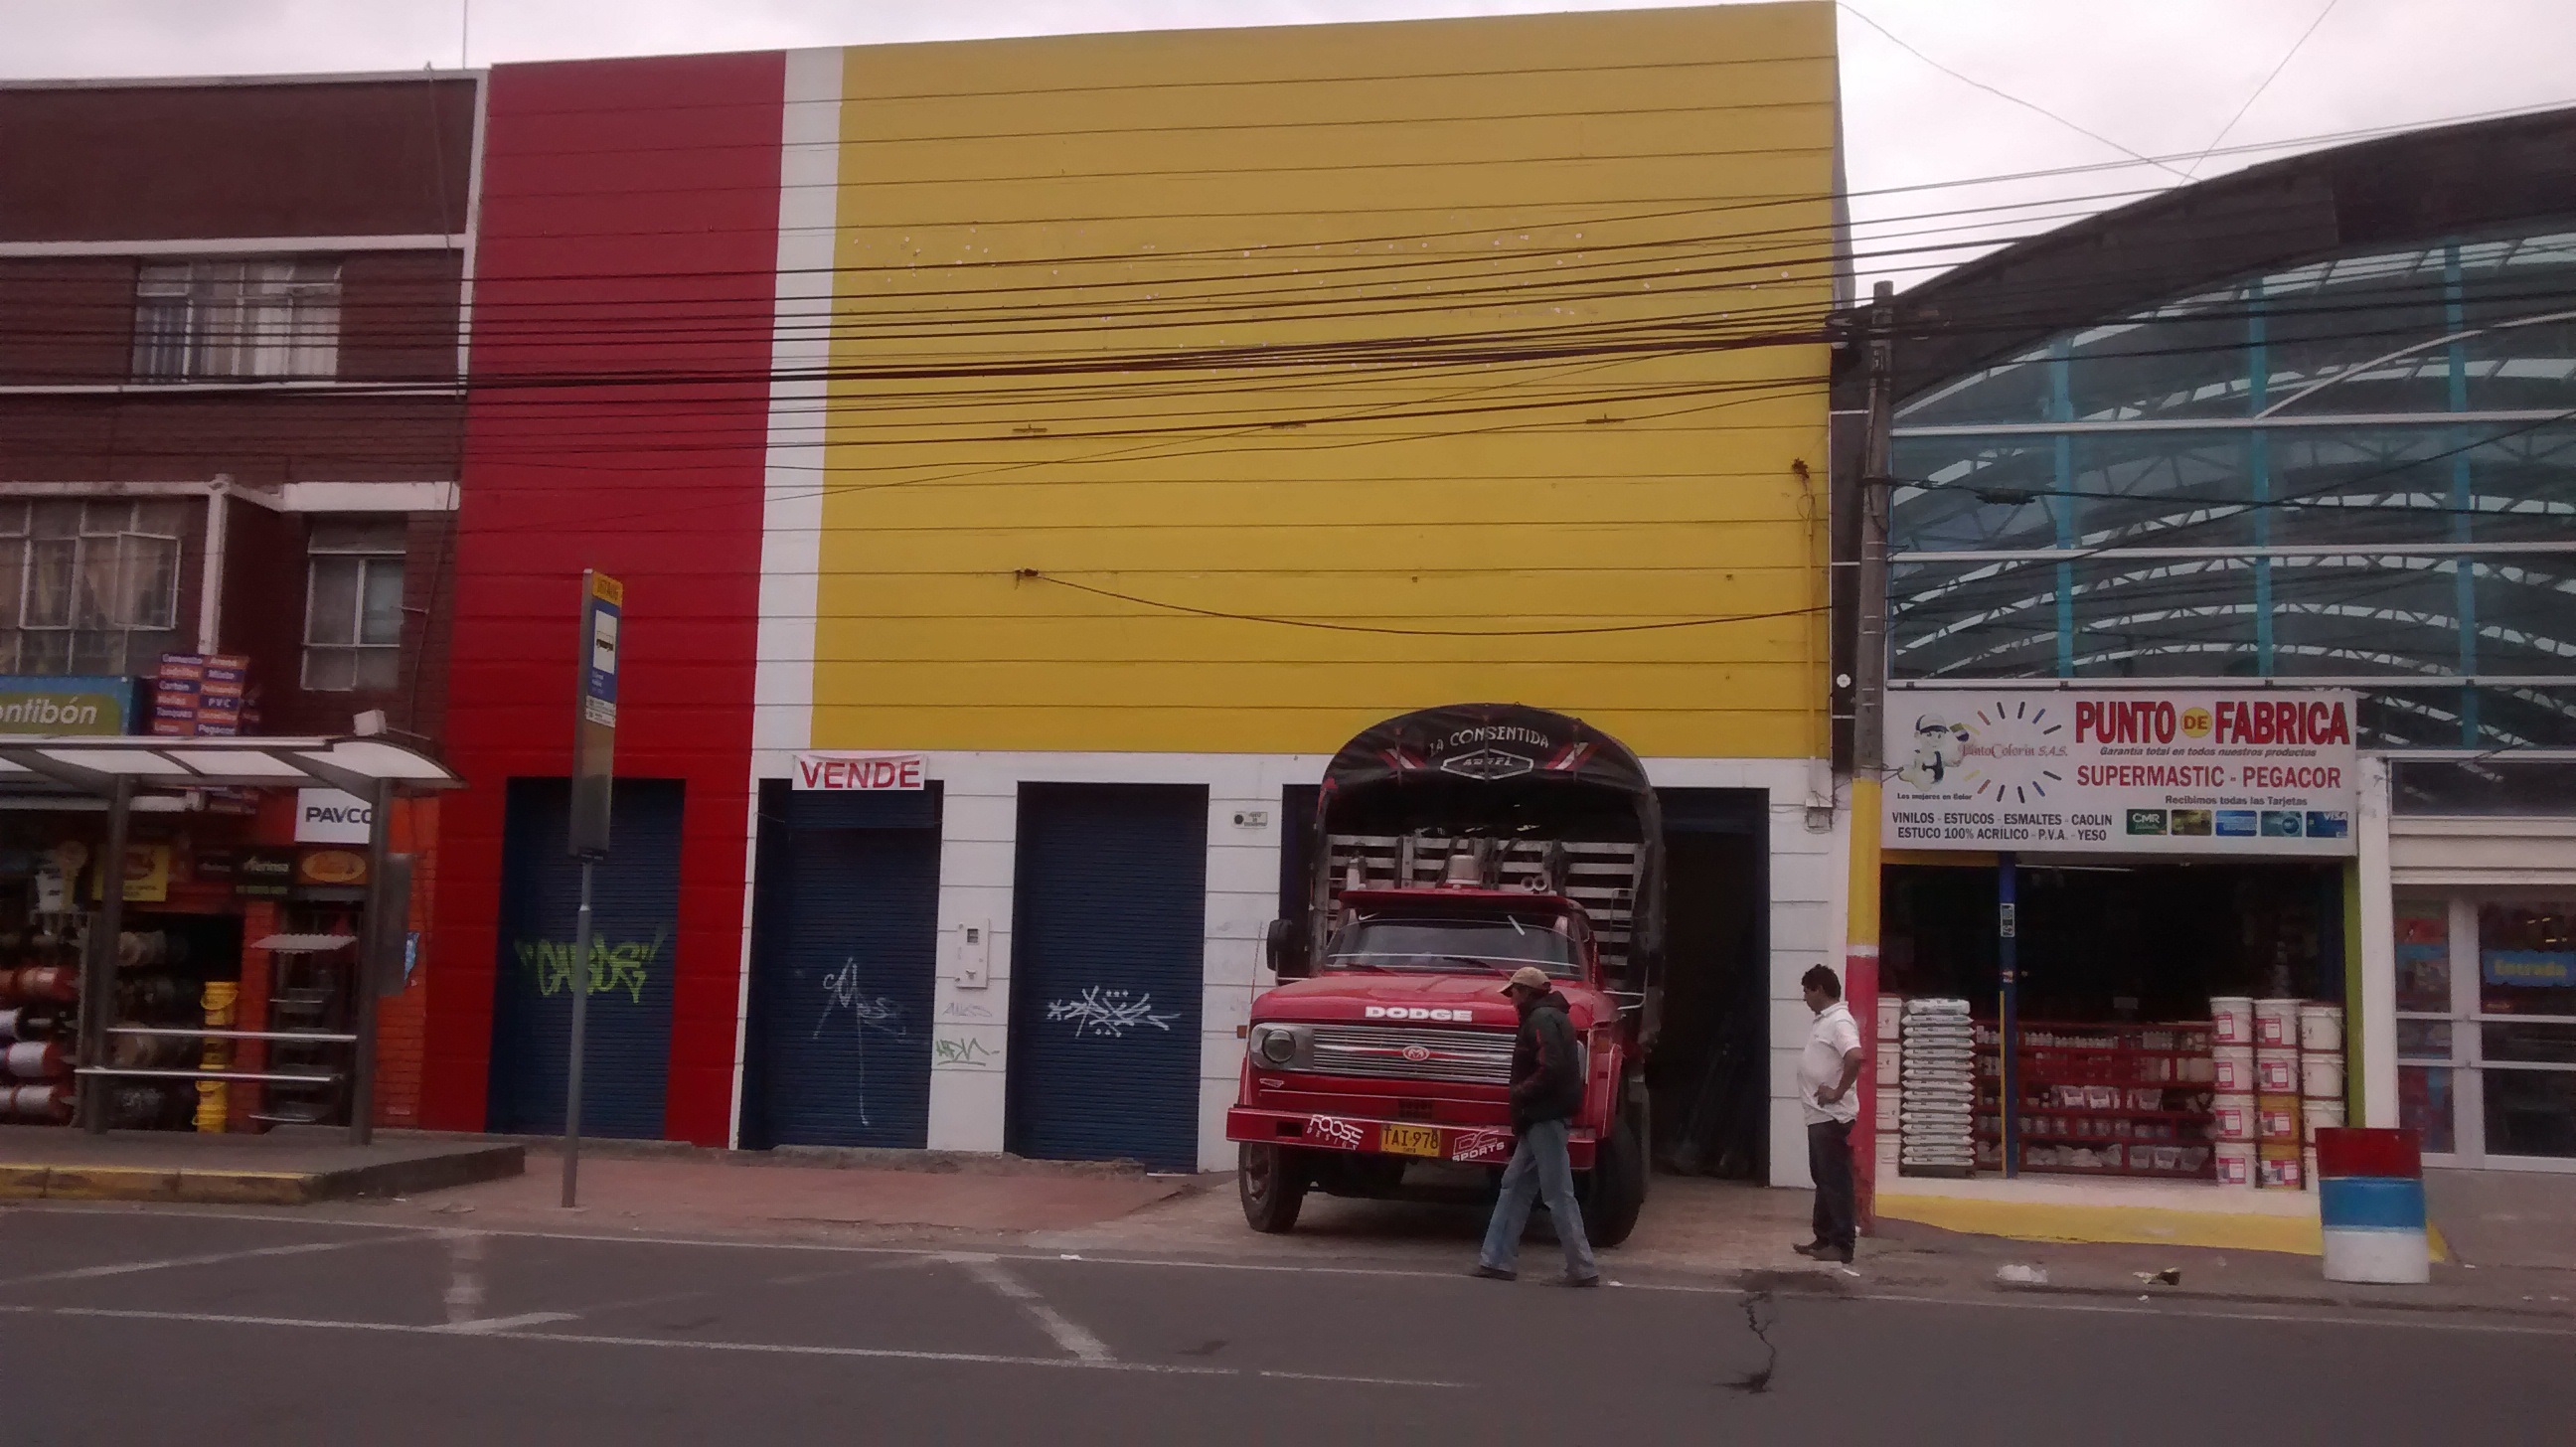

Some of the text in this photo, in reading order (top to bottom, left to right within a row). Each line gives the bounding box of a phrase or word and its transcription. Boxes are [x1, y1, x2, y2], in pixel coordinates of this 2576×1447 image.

[0, 696, 97, 724] ntibón
[2075, 701, 2350, 745] PUNTO DE FABRICA
[1450, 725, 1549, 748] CONSENTIDA
[2146, 746, 2170, 756] total
[2187, 746, 2215, 756] todos
[800, 760, 920, 788] VENDE
[2077, 764, 2341, 788] SUPERMASTIC PEGACOR
[2165, 795, 2308, 808] Recibimos todas las Tarjetas
[1892, 812, 2112, 826] VINILOS ESTUCOS ESMALTES CAOLIN
[2132, 812, 2161, 824] CMR
[1897, 827, 1941, 839] ESTUCO
[1945, 828, 1974, 840] 100%
[2078, 830, 2107, 841] YESO
[1366, 1006, 1473, 1023] DODGE
[1309, 1114, 1364, 1145] FOOSE
[1452, 1142, 1505, 1162] SPORTS
